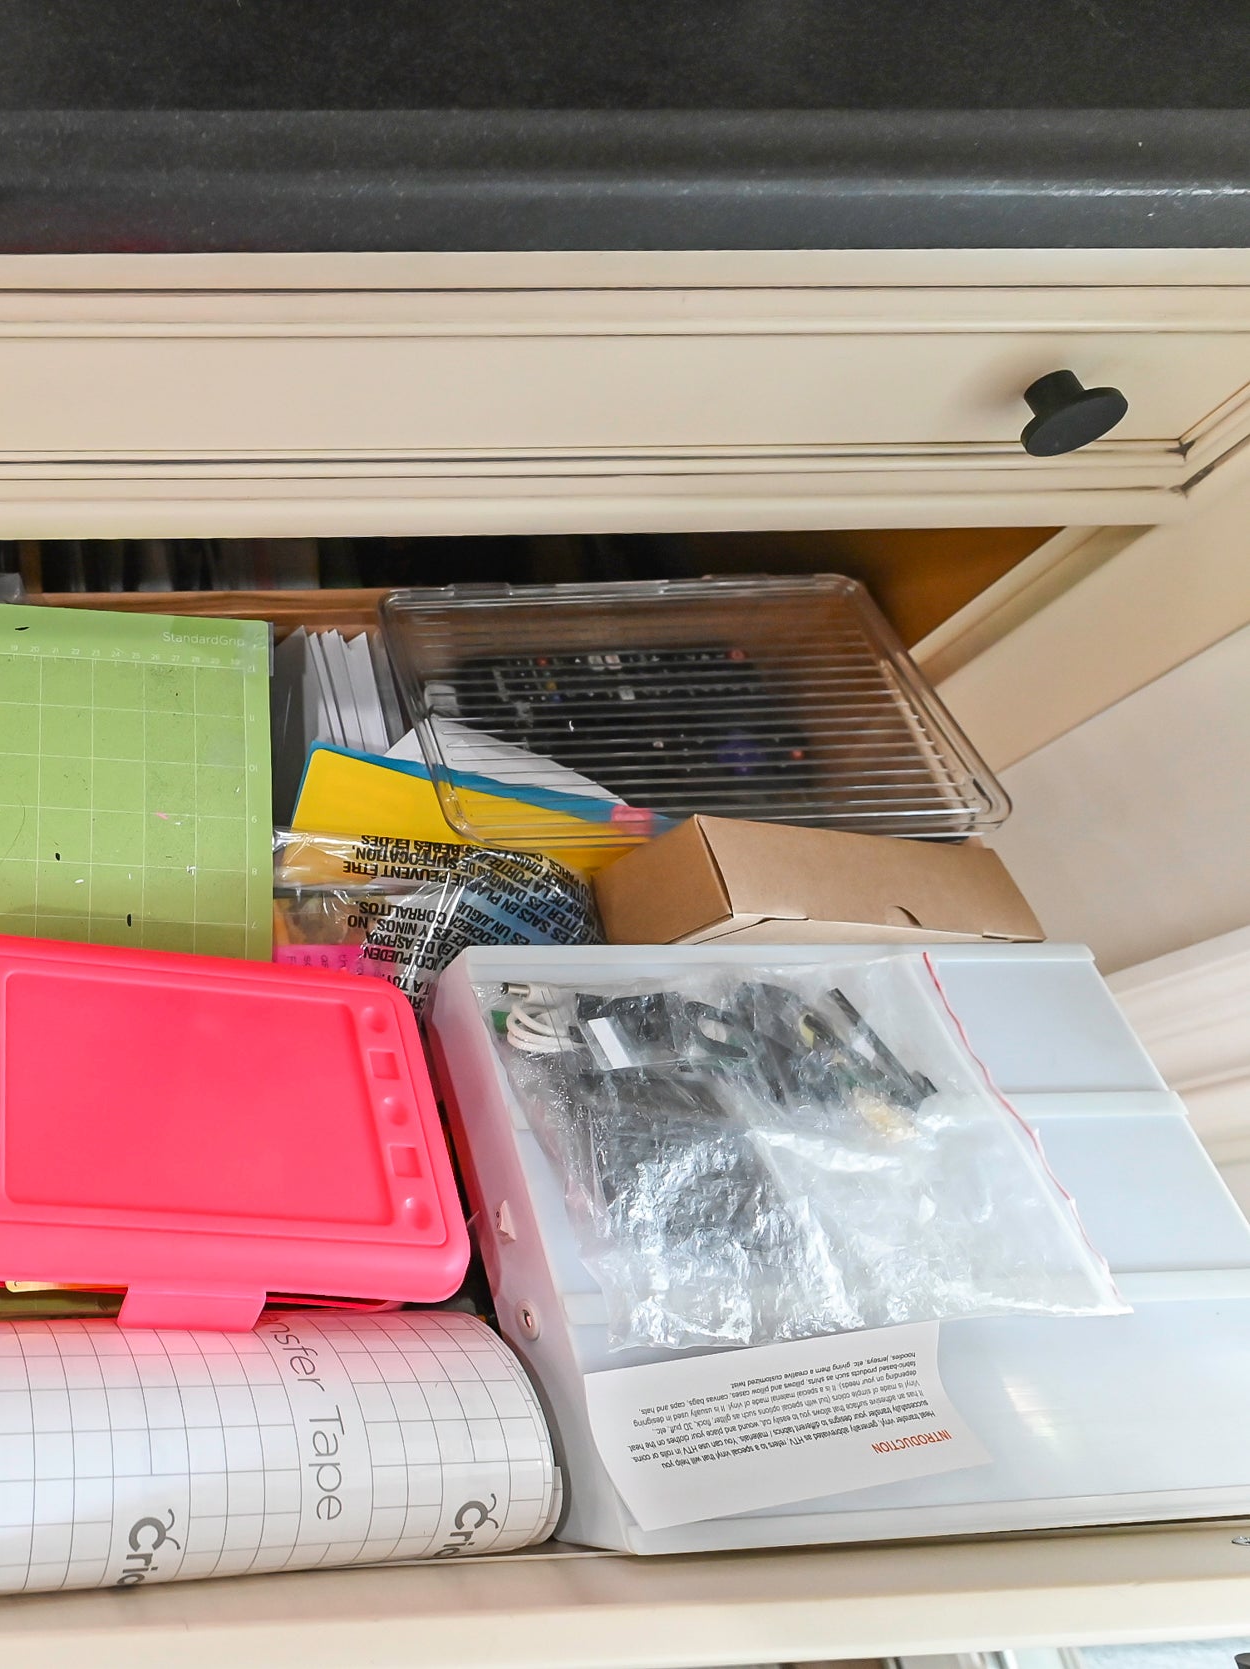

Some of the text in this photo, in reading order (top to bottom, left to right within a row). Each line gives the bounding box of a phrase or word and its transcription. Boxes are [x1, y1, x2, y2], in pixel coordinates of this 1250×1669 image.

[162, 631, 245, 647] StandardGrip
[380, 864, 448, 883] PEUVENT
[499, 898, 520, 915] EN
[346, 914, 368, 929] NO
[490, 920, 511, 938] UN
[516, 908, 551, 933] SACS
[363, 946, 412, 965] PUEDEN
[870, 1428, 951, 1454] INTRODUCTION
[307, 1404, 345, 1521] Tape
